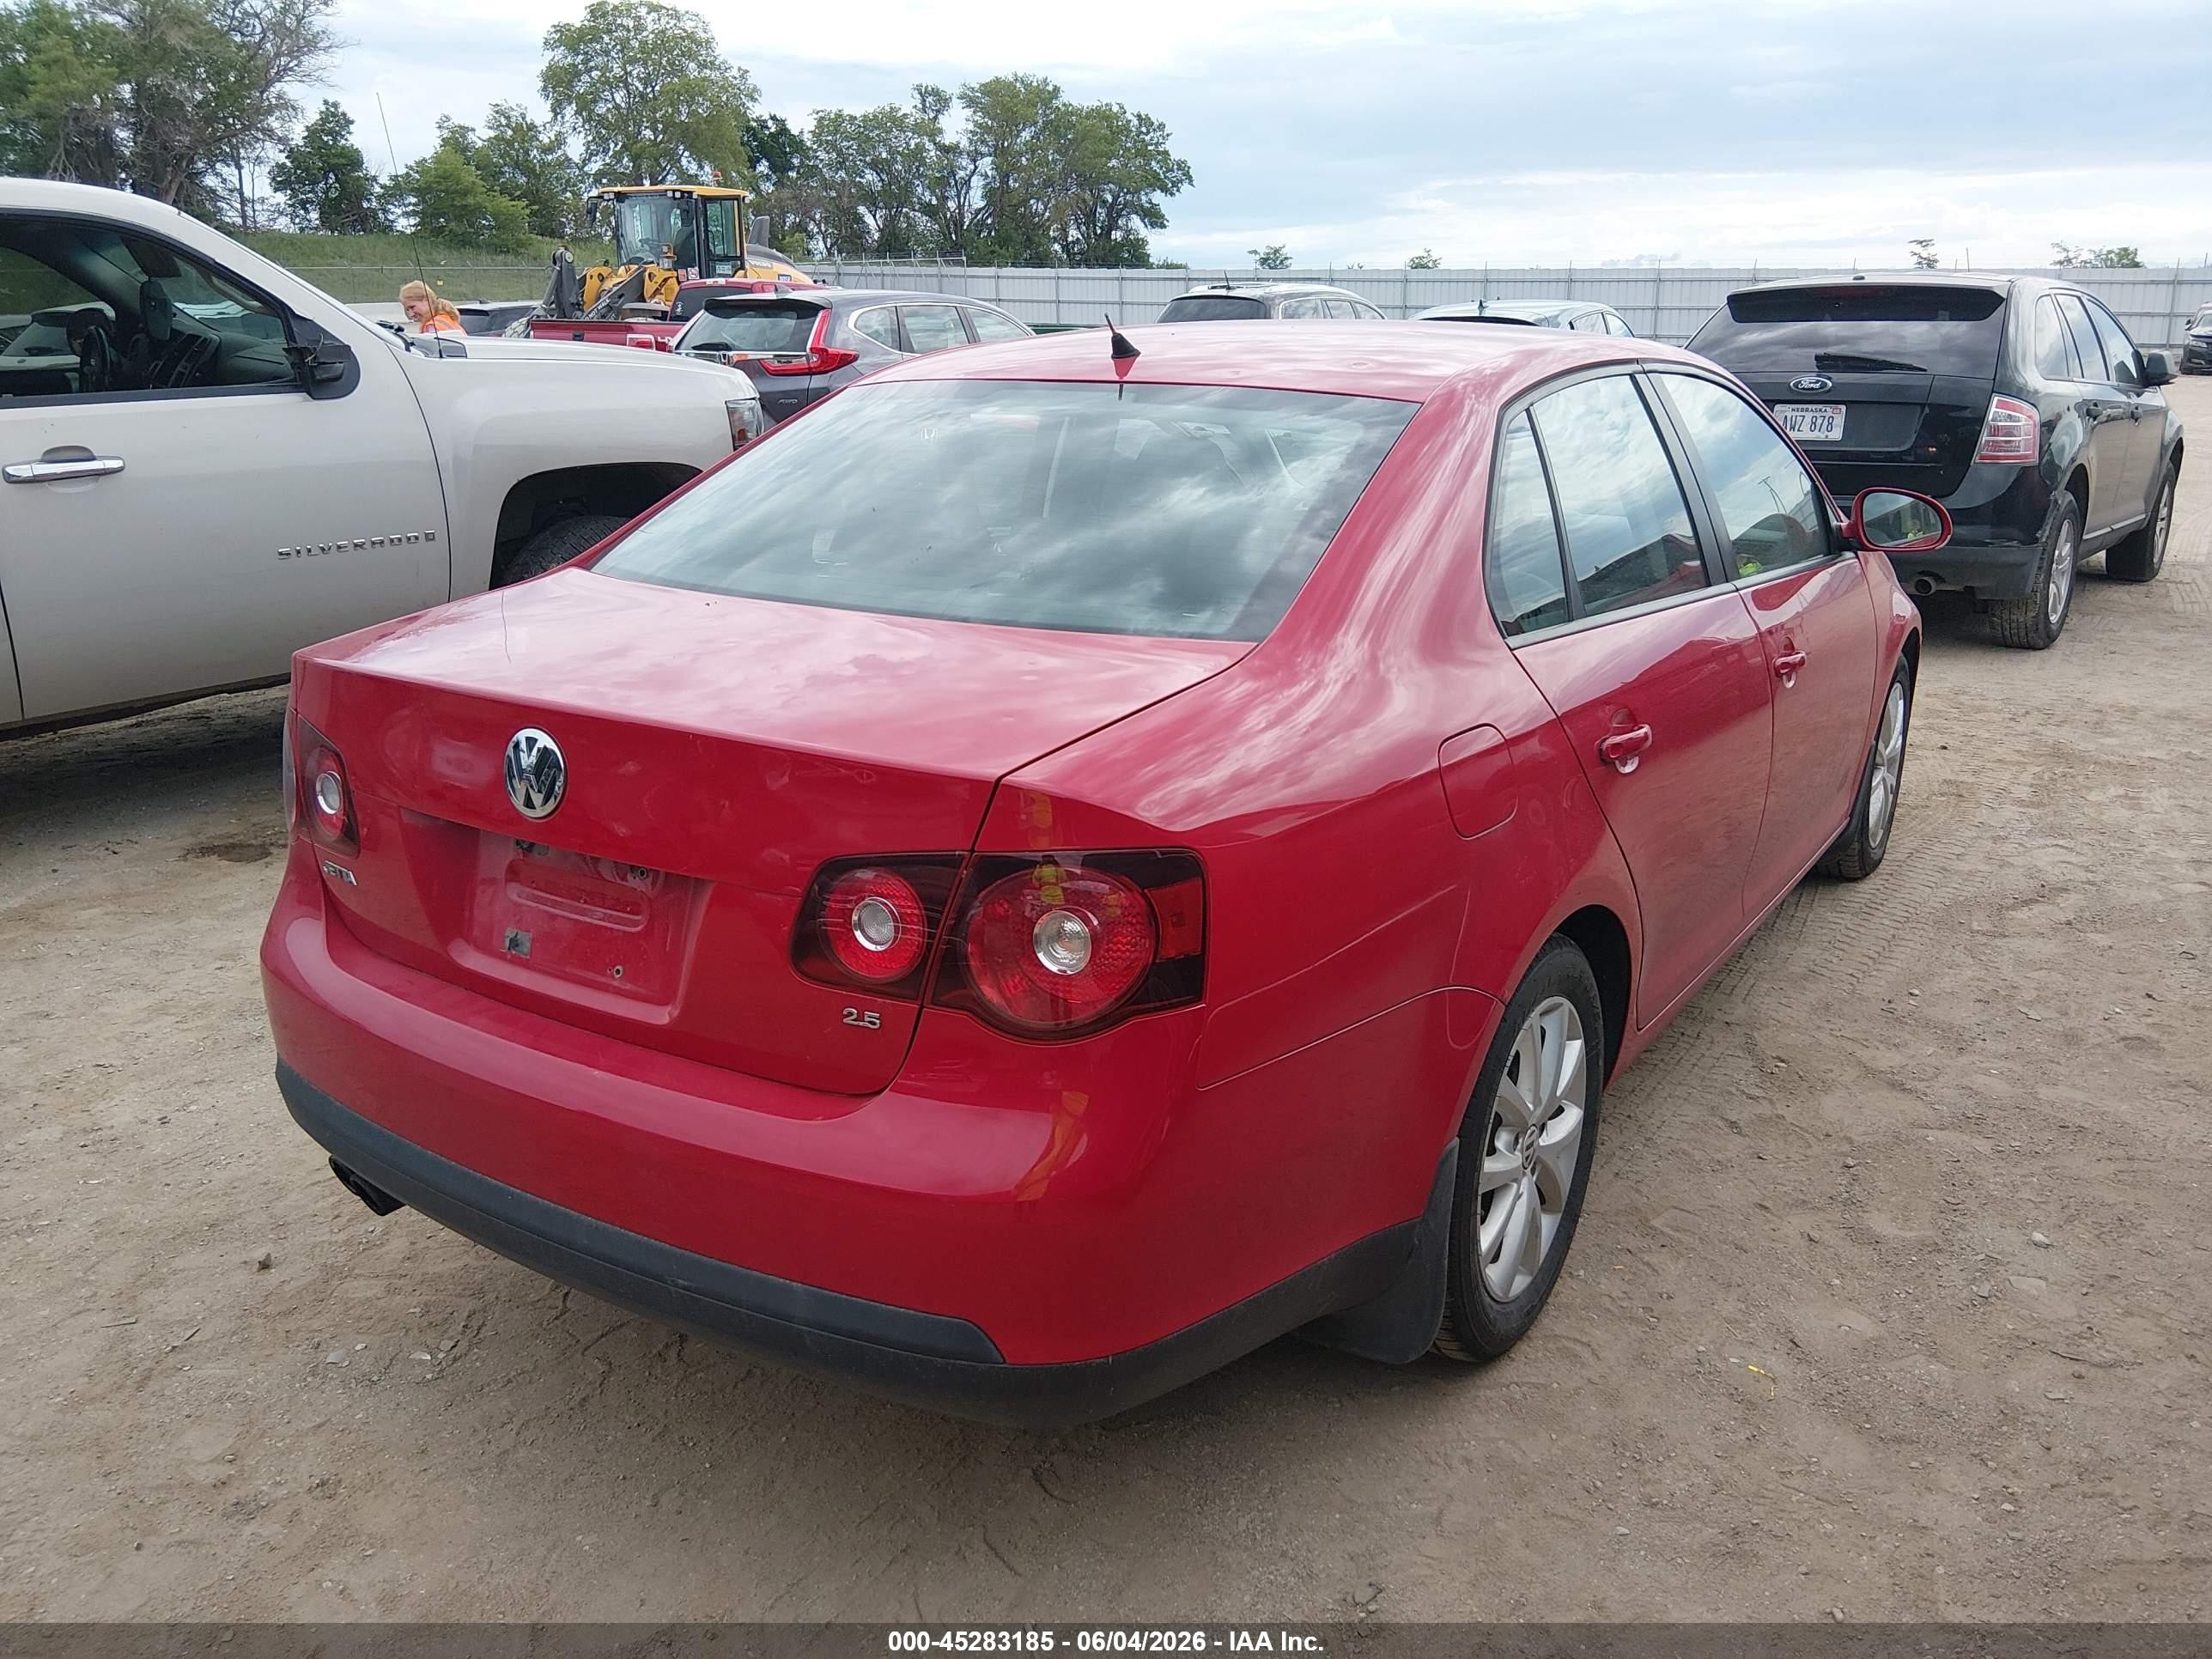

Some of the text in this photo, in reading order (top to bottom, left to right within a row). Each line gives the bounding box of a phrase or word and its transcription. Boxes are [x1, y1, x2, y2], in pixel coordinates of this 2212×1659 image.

[1782, 415, 1835, 433] AWZ 878
[276, 532, 421, 561] SILVERADO
[842, 1007, 880, 1030] 2.5
